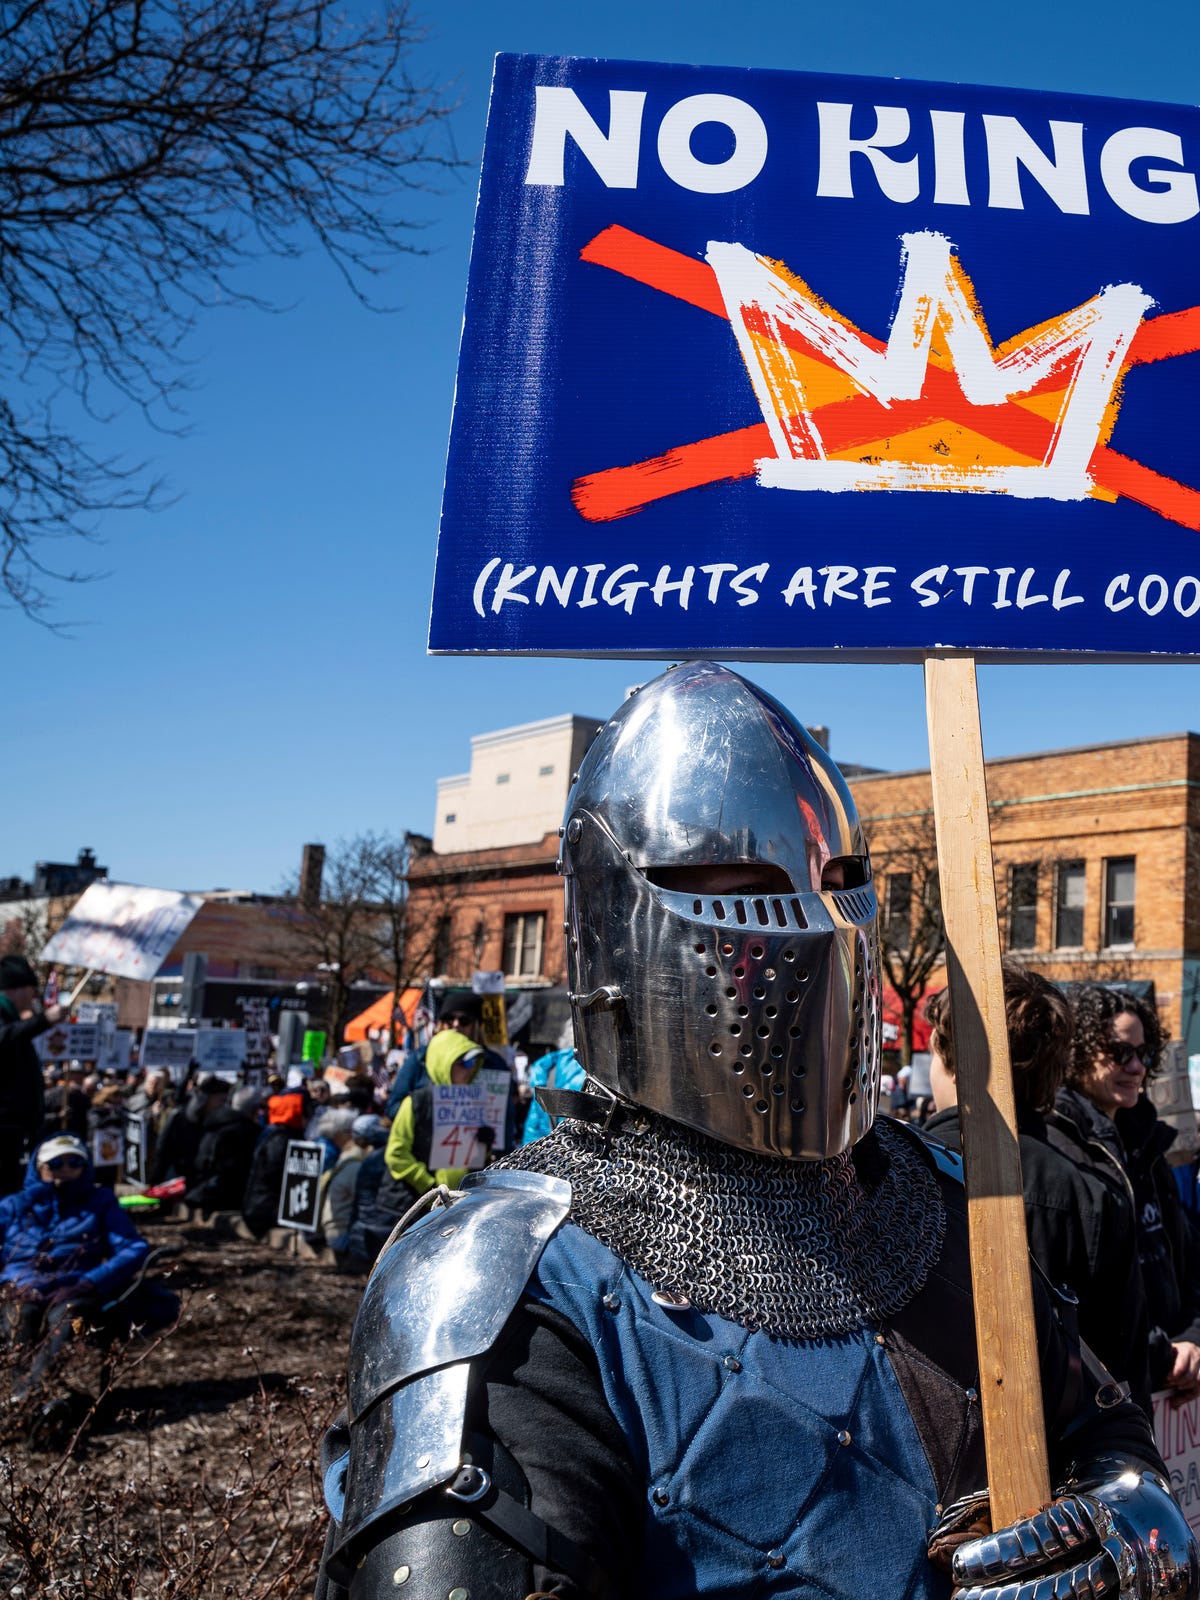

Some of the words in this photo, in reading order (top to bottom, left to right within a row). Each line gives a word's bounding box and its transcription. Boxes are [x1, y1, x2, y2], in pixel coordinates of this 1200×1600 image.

[525, 86, 768, 194] NO
[473, 557, 771, 617] (KNIGHTS
[780, 565, 896, 609] ARE
[911, 564, 1084, 611] STILL
[437, 1107, 456, 1120] ON
[441, 1124, 481, 1167] 47
